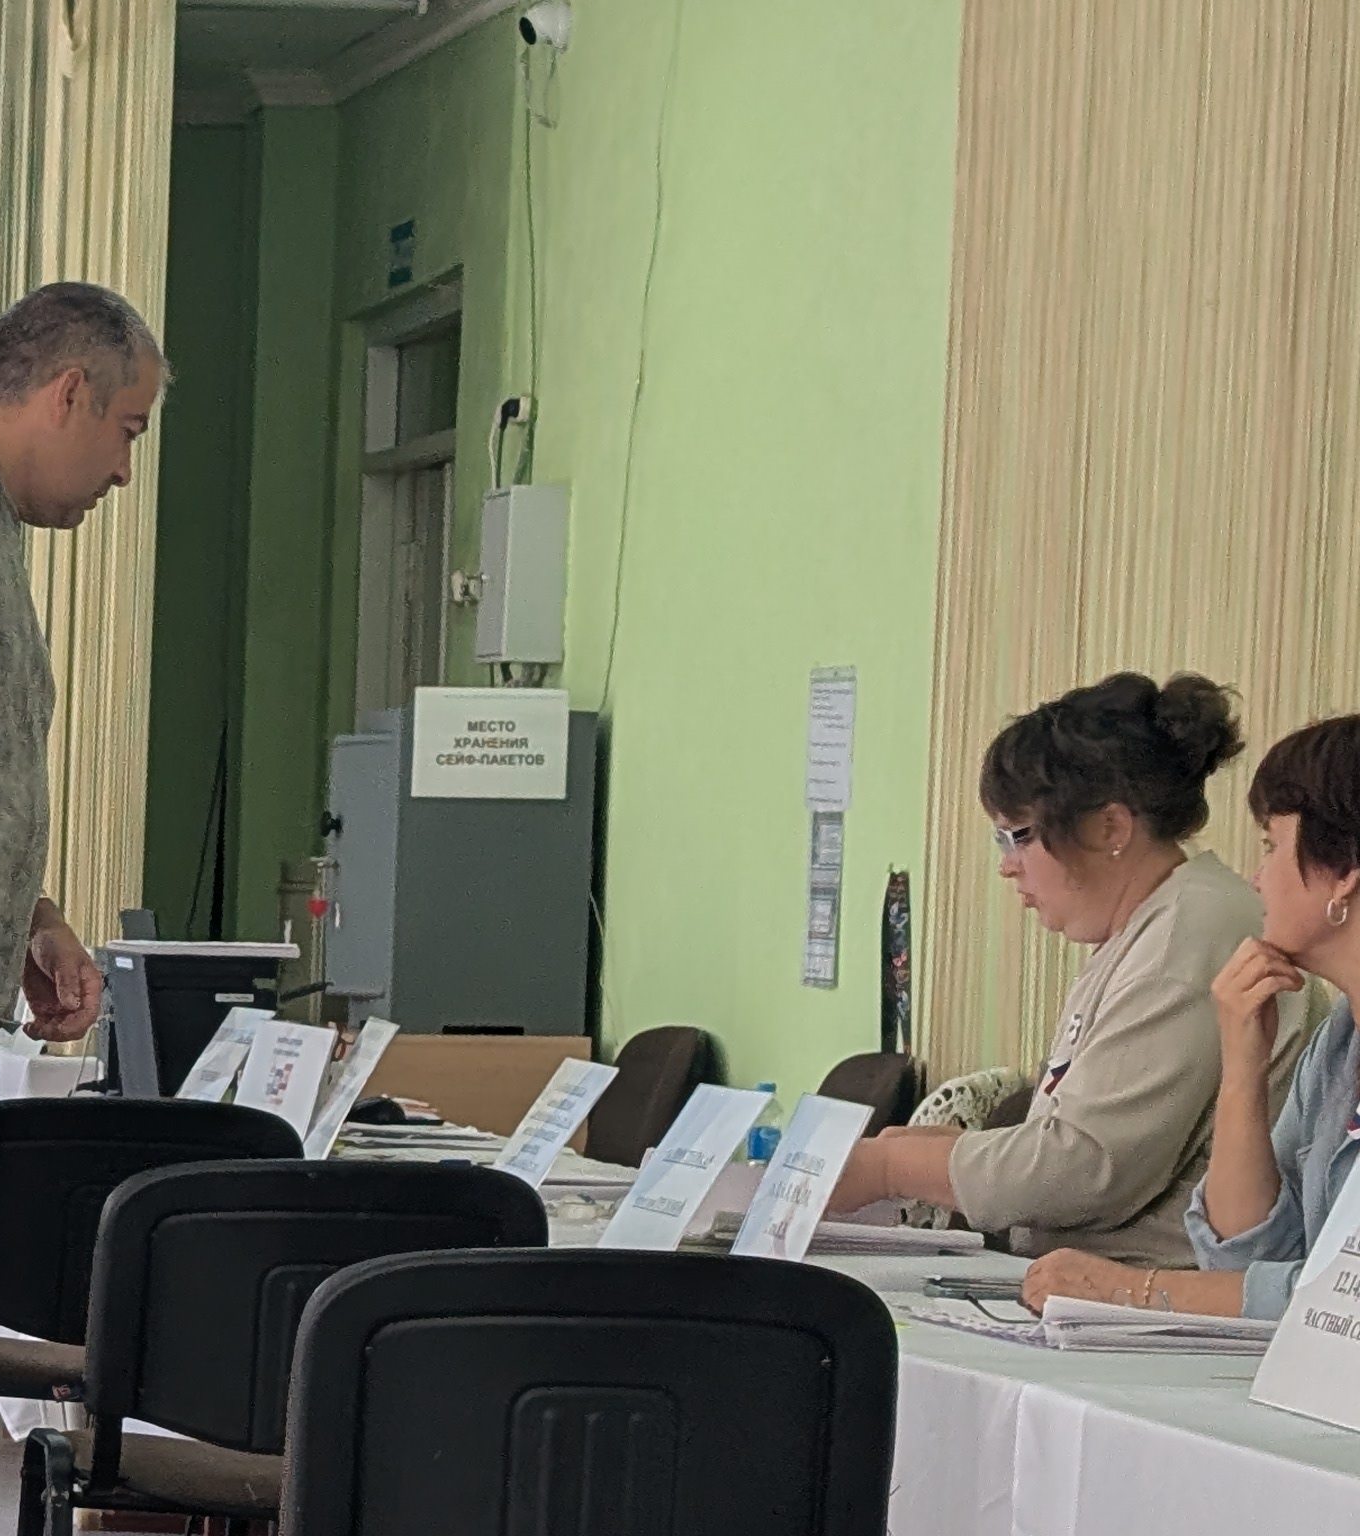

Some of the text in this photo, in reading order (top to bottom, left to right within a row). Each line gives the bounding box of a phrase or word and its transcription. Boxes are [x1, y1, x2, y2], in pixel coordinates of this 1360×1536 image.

[467, 720, 516, 732] МЕСТО
[453, 737, 529, 749] ХРАНЕНИЯ
[435, 752, 545, 766] СЕЙФ-ПАКЕТОВ
